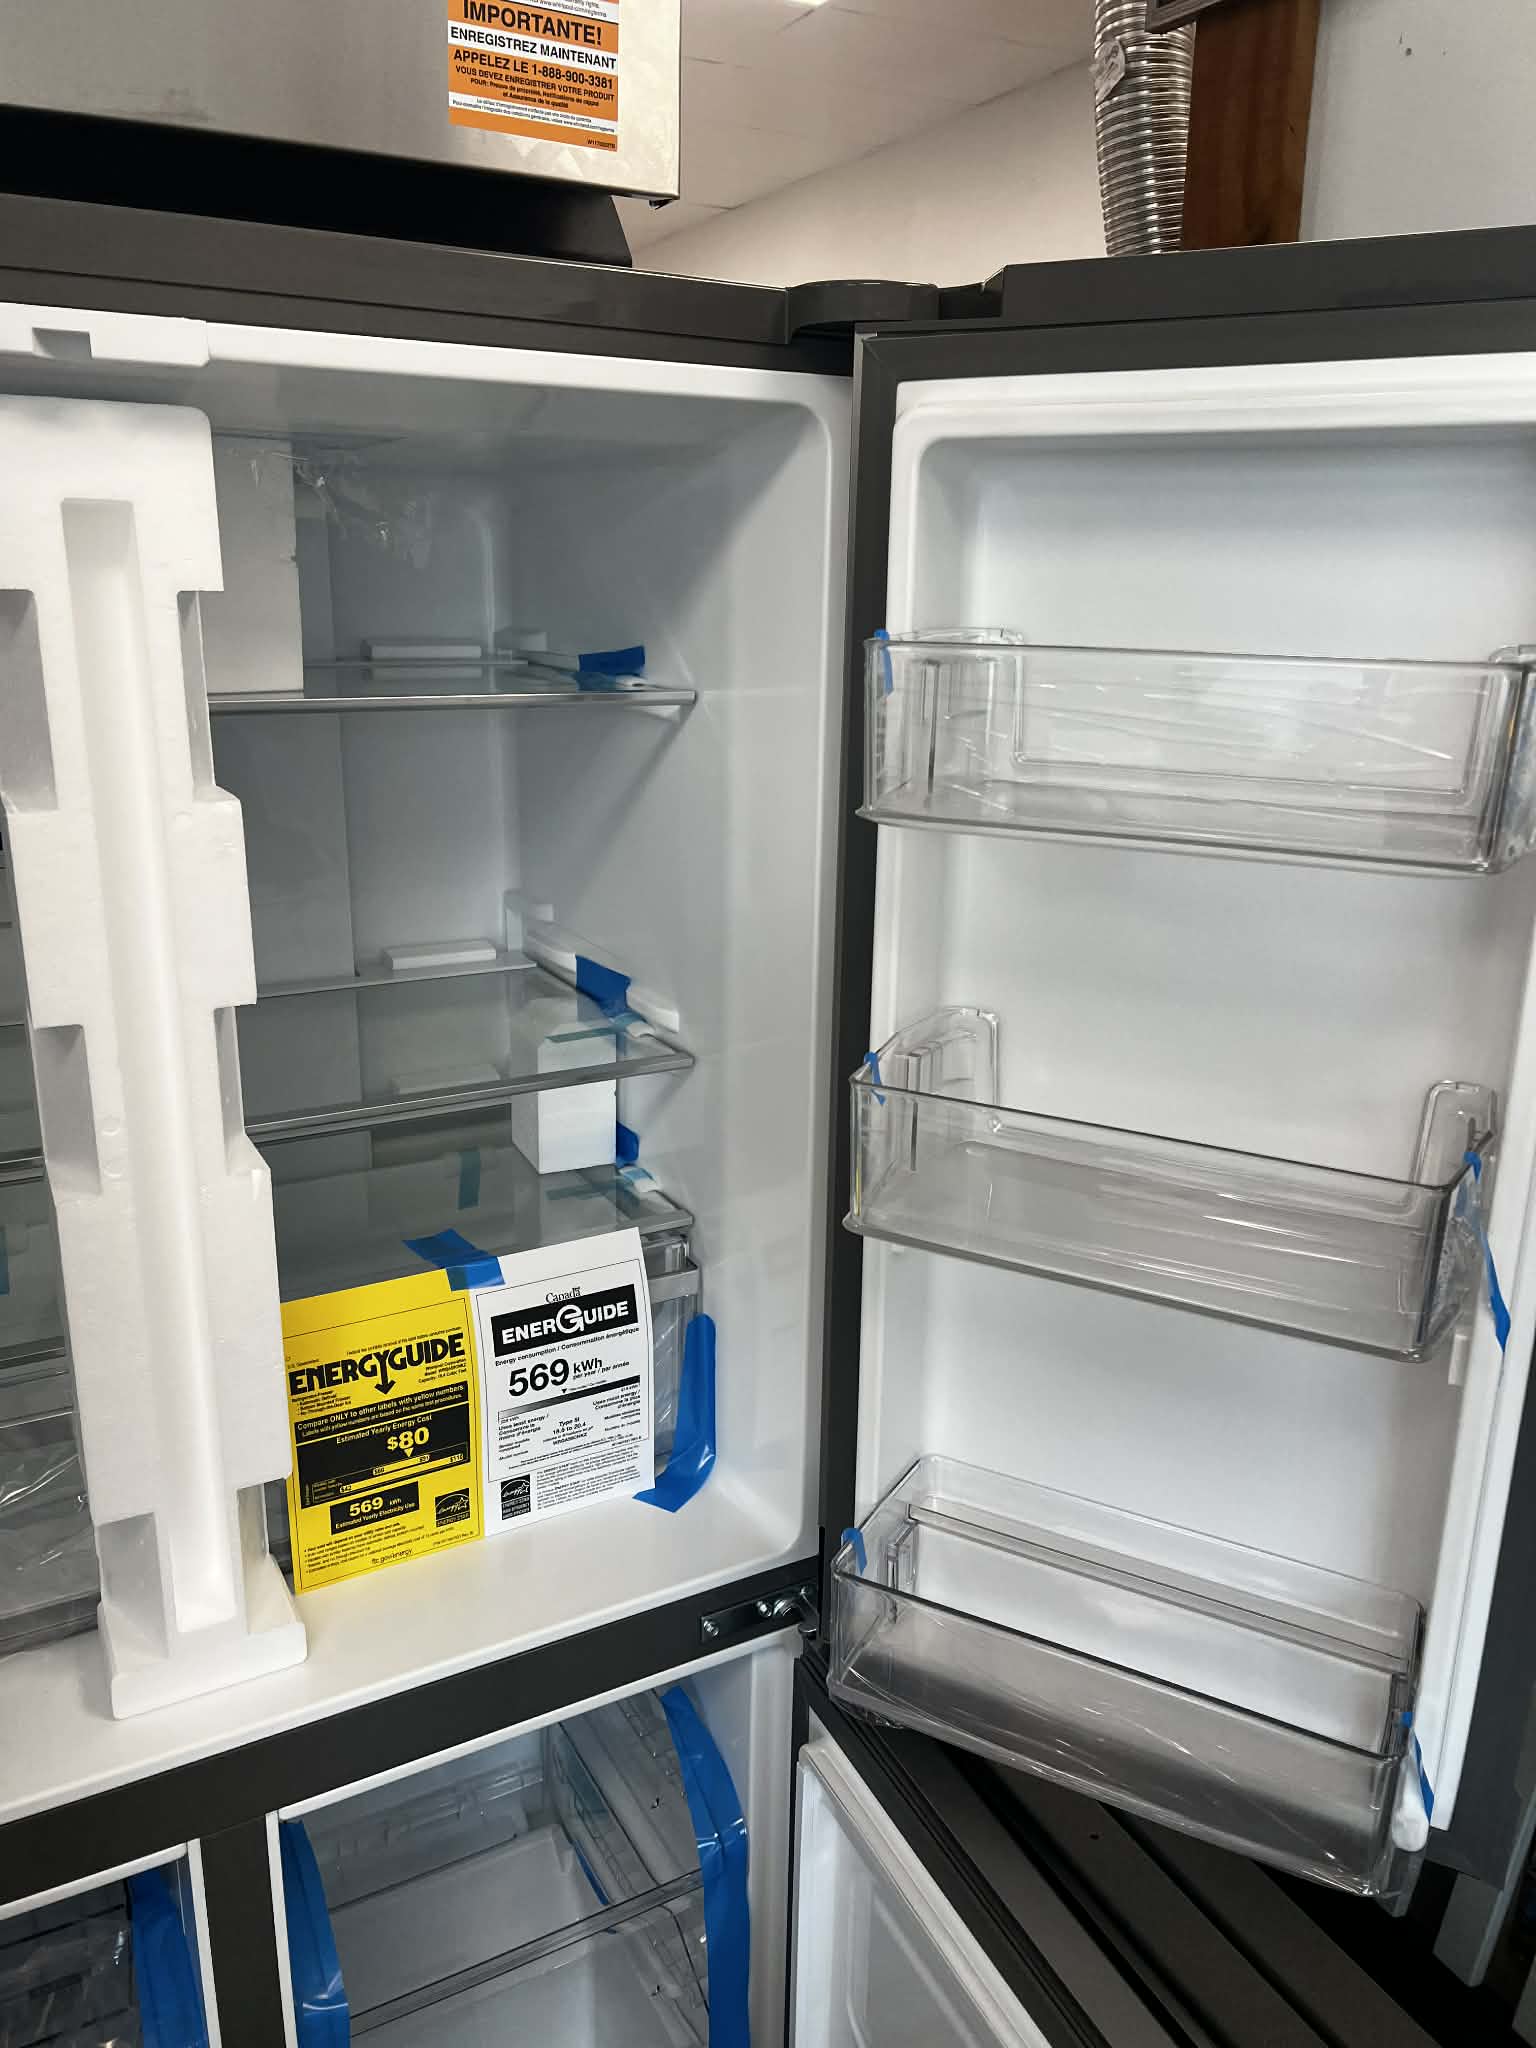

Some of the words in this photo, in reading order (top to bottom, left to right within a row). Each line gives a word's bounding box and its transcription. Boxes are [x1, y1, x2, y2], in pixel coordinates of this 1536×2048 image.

[463, 0, 602, 46] IMPORTANTE!
[451, 26, 538, 54] ENREGISTREZ
[540, 44, 617, 70] MAINTENANT
[454, 49, 510, 70] APPELEZ
[513, 60, 529, 74] LE
[531, 64, 613, 90] 1-888-900-3381
[455, 65, 477, 76] VOUS
[478, 70, 503, 81] DEVEZ
[504, 74, 556, 91] ENREGISTRER
[558, 84, 583, 96] VOTRE
[583, 88, 615, 102] PRODUIT
[545, 1286, 581, 1304] Canada
[501, 1300, 629, 1345] ENERGUIDE
[288, 1333, 465, 1395] ENERGYGUIDE
[495, 1356, 517, 1367] Energy
[560, 1334, 606, 1350] Consommation
[573, 1357, 603, 1374] kWh
[508, 1358, 570, 1397] 569
[297, 1418, 329, 1431] Compare
[330, 1412, 349, 1423] ONLY
[358, 1405, 376, 1415] other
[377, 1400, 398, 1411] labels
[398, 1396, 413, 1405] with
[414, 1392, 435, 1402] yellow
[435, 1384, 464, 1396] numbers
[336, 1430, 370, 1445] Estimated
[370, 1424, 391, 1436] Yearly
[392, 1418, 415, 1430] Energy
[416, 1413, 433, 1423] Cost
[386, 1426, 430, 1451] $80
[335, 1517, 362, 1530] Estimated
[362, 1511, 379, 1523] Yearly
[379, 1504, 405, 1519] Electricity
[349, 1496, 384, 1517] 569
[389, 1497, 402, 1506] kWh
